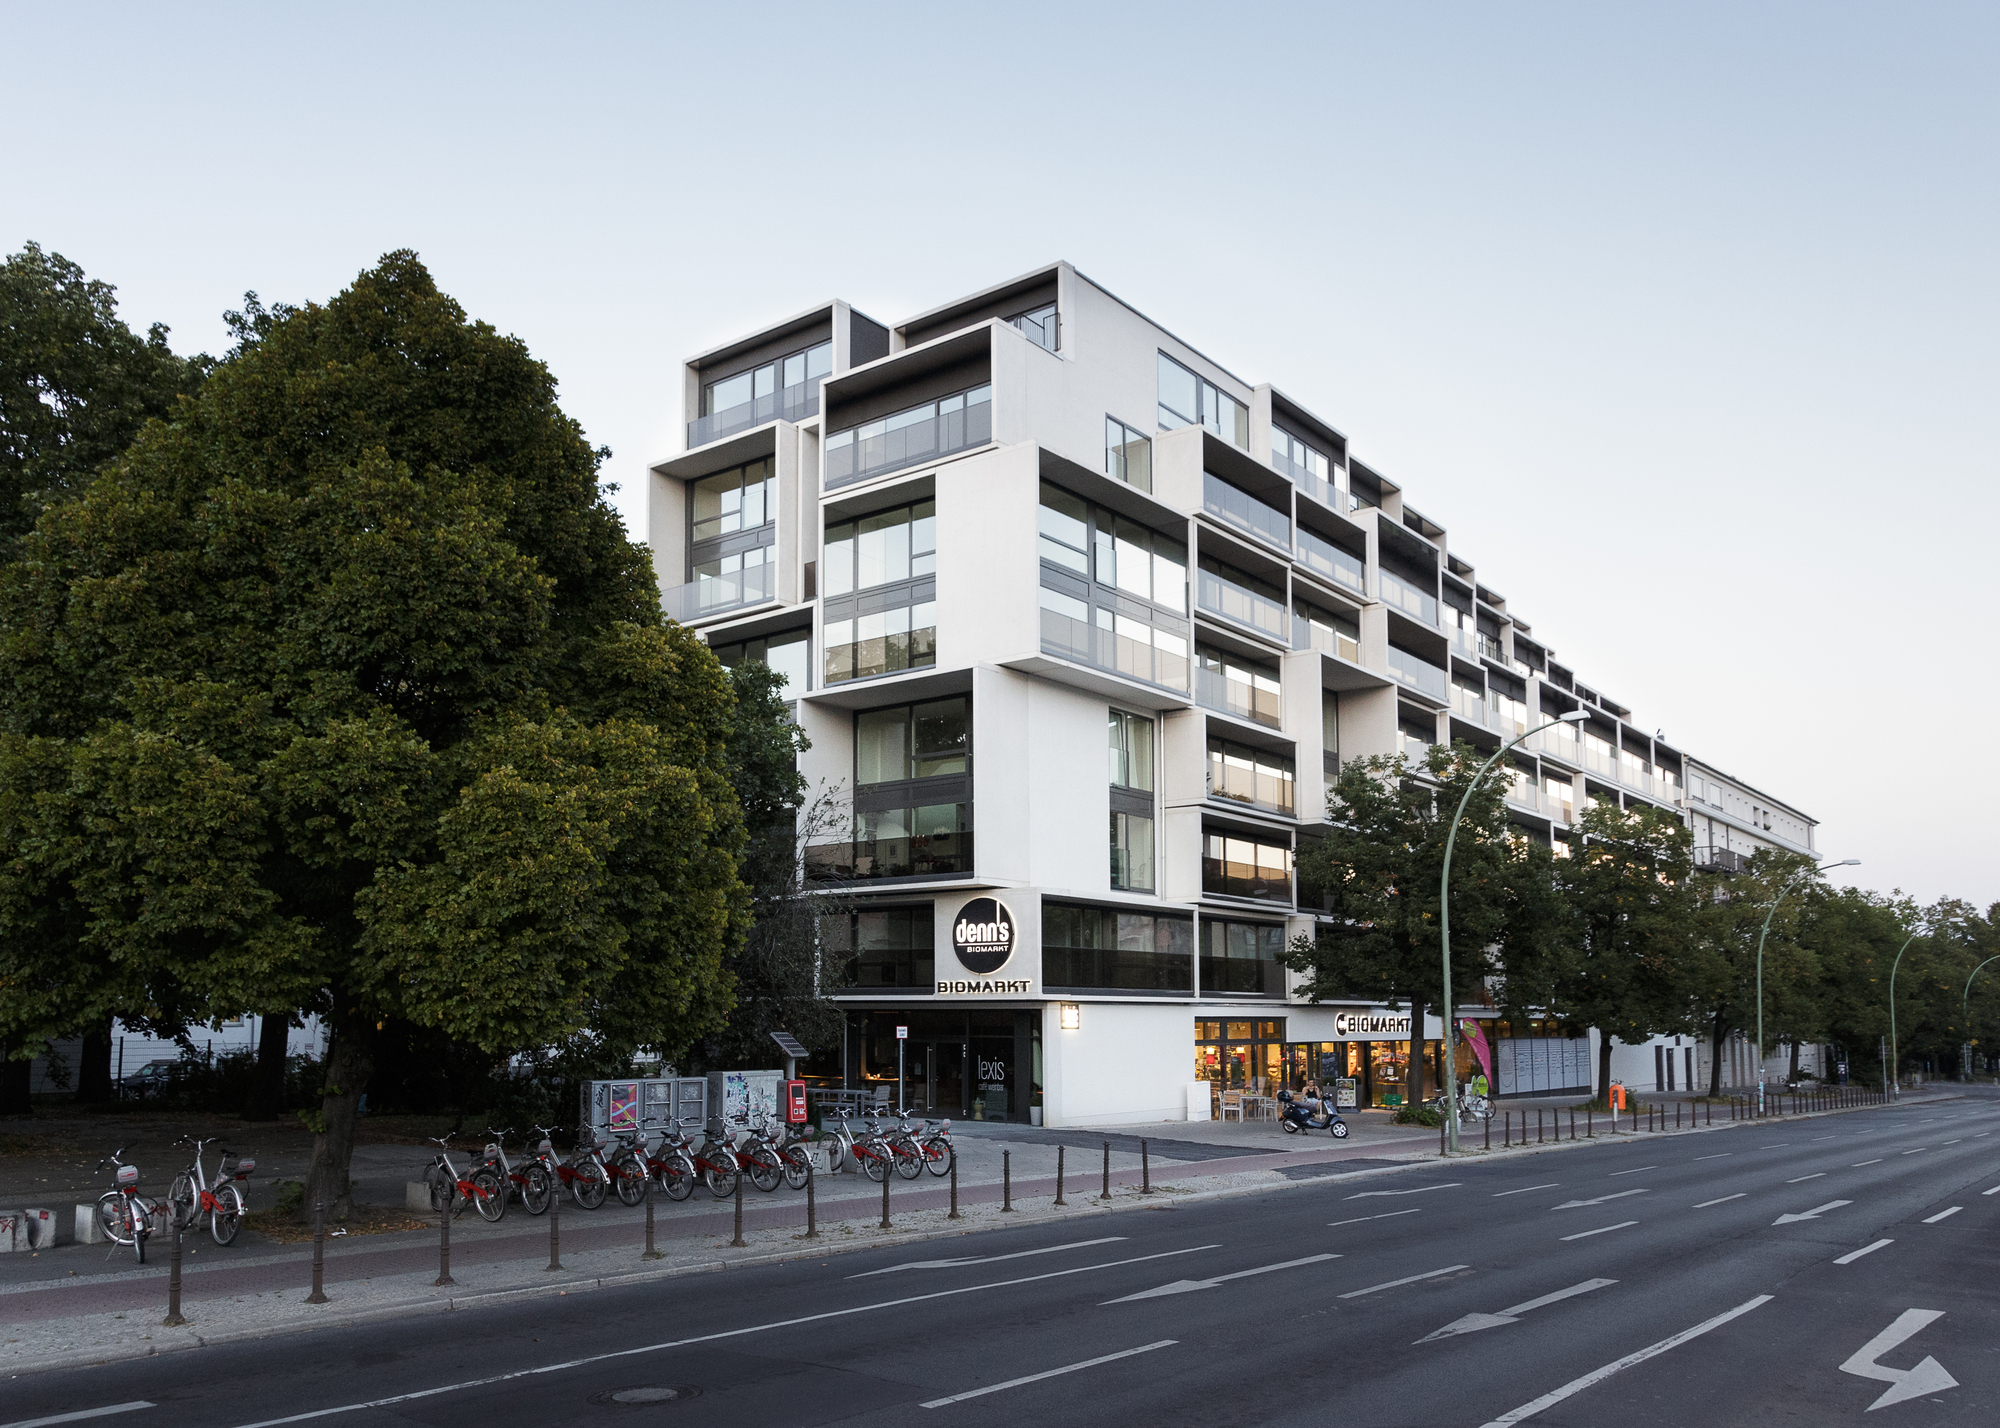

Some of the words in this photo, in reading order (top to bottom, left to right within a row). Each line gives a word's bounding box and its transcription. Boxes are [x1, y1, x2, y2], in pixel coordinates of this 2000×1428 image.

[938, 980, 1030, 993] BIOMARKT
[1347, 1017, 1411, 1032] BIOMARKT
[978, 1055, 1005, 1080] lexis
